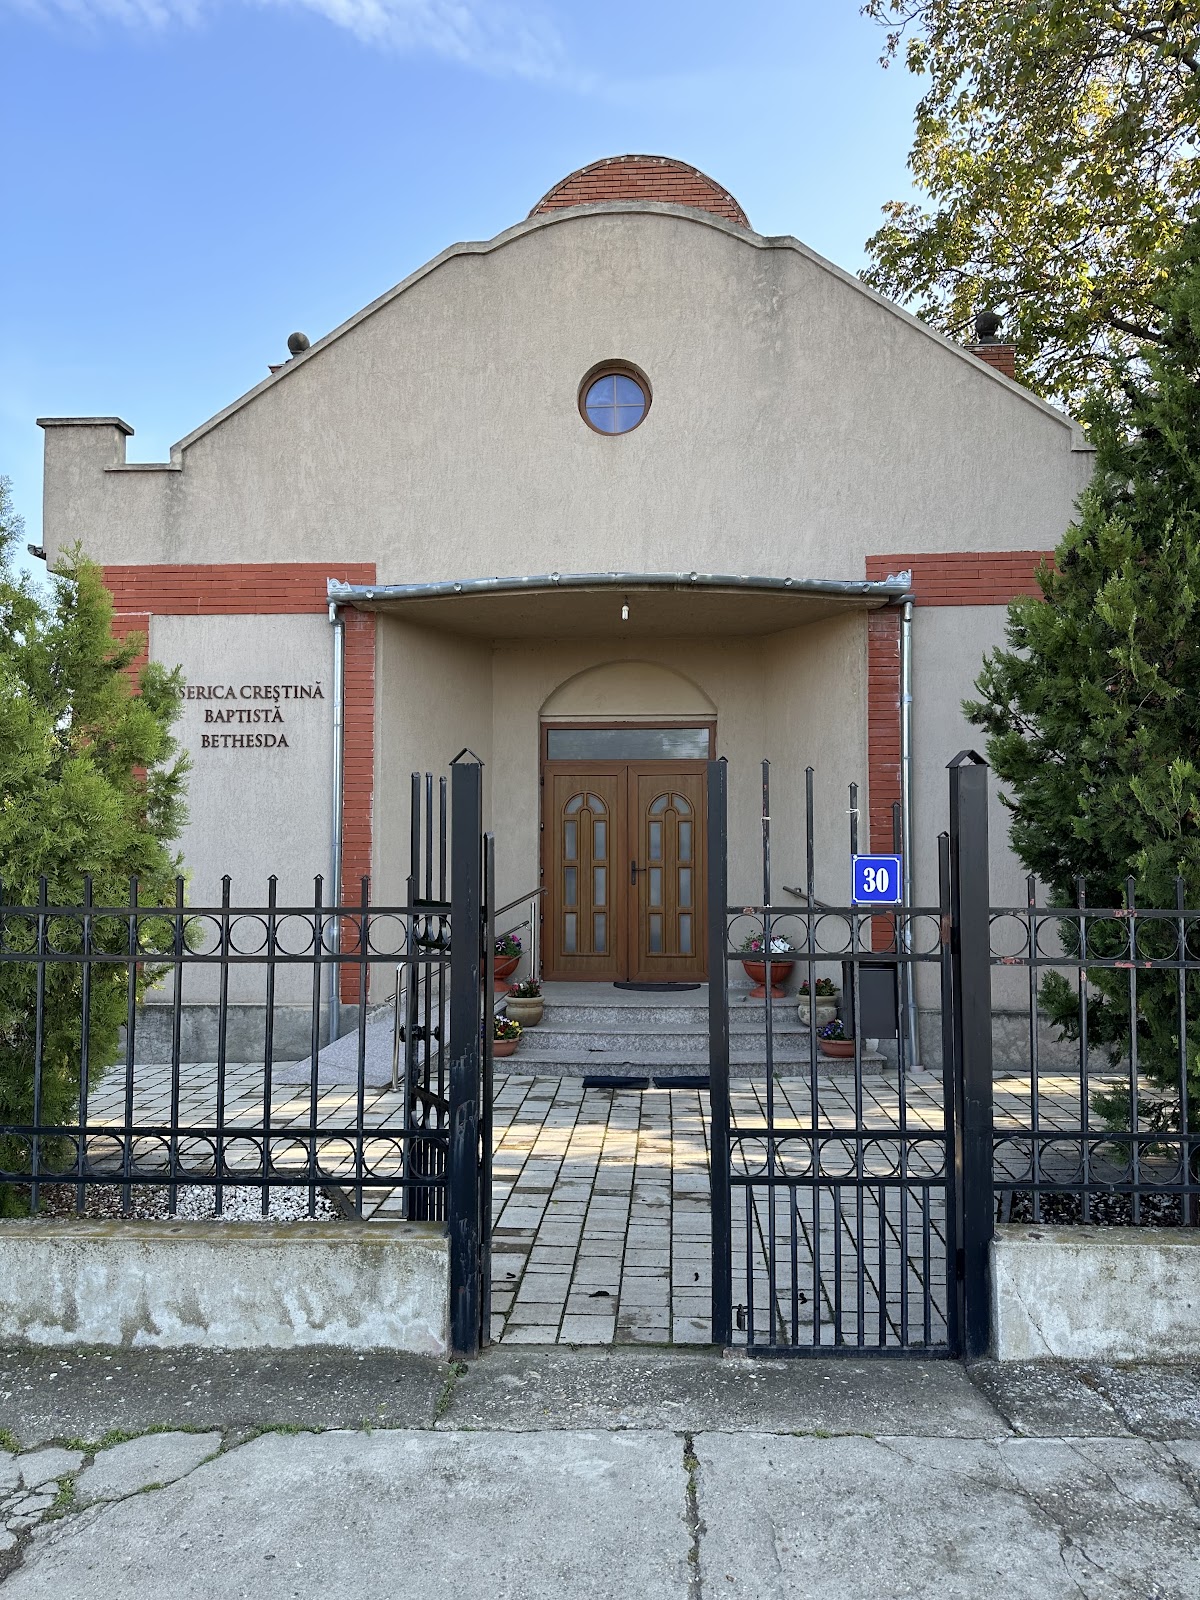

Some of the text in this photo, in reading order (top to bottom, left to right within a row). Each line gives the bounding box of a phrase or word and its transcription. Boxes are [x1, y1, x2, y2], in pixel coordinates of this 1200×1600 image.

[179, 681, 324, 702] SERICA CREŞTINĂ
[204, 706, 284, 723] BAPTISTĂ
[201, 734, 289, 748] BETHESDA
[863, 867, 889, 893] 30
